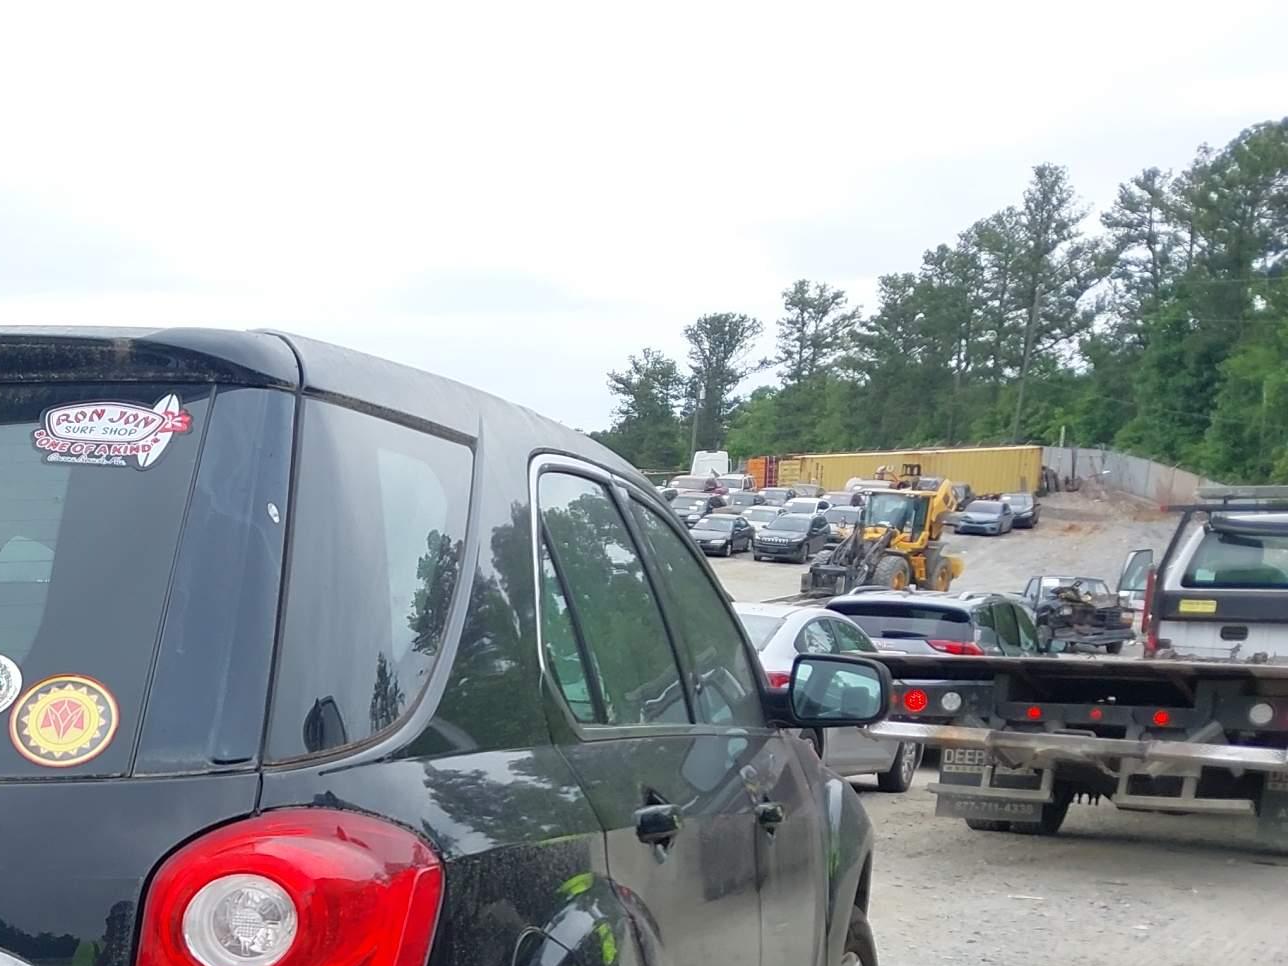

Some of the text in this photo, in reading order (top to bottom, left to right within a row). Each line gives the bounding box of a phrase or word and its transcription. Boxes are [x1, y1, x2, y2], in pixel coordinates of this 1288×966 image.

[56, 408, 156, 428] RON JON
[64, 425, 138, 437] SURF SHOP
[70, 442, 96, 455] OF
[95, 443, 109, 455] A
